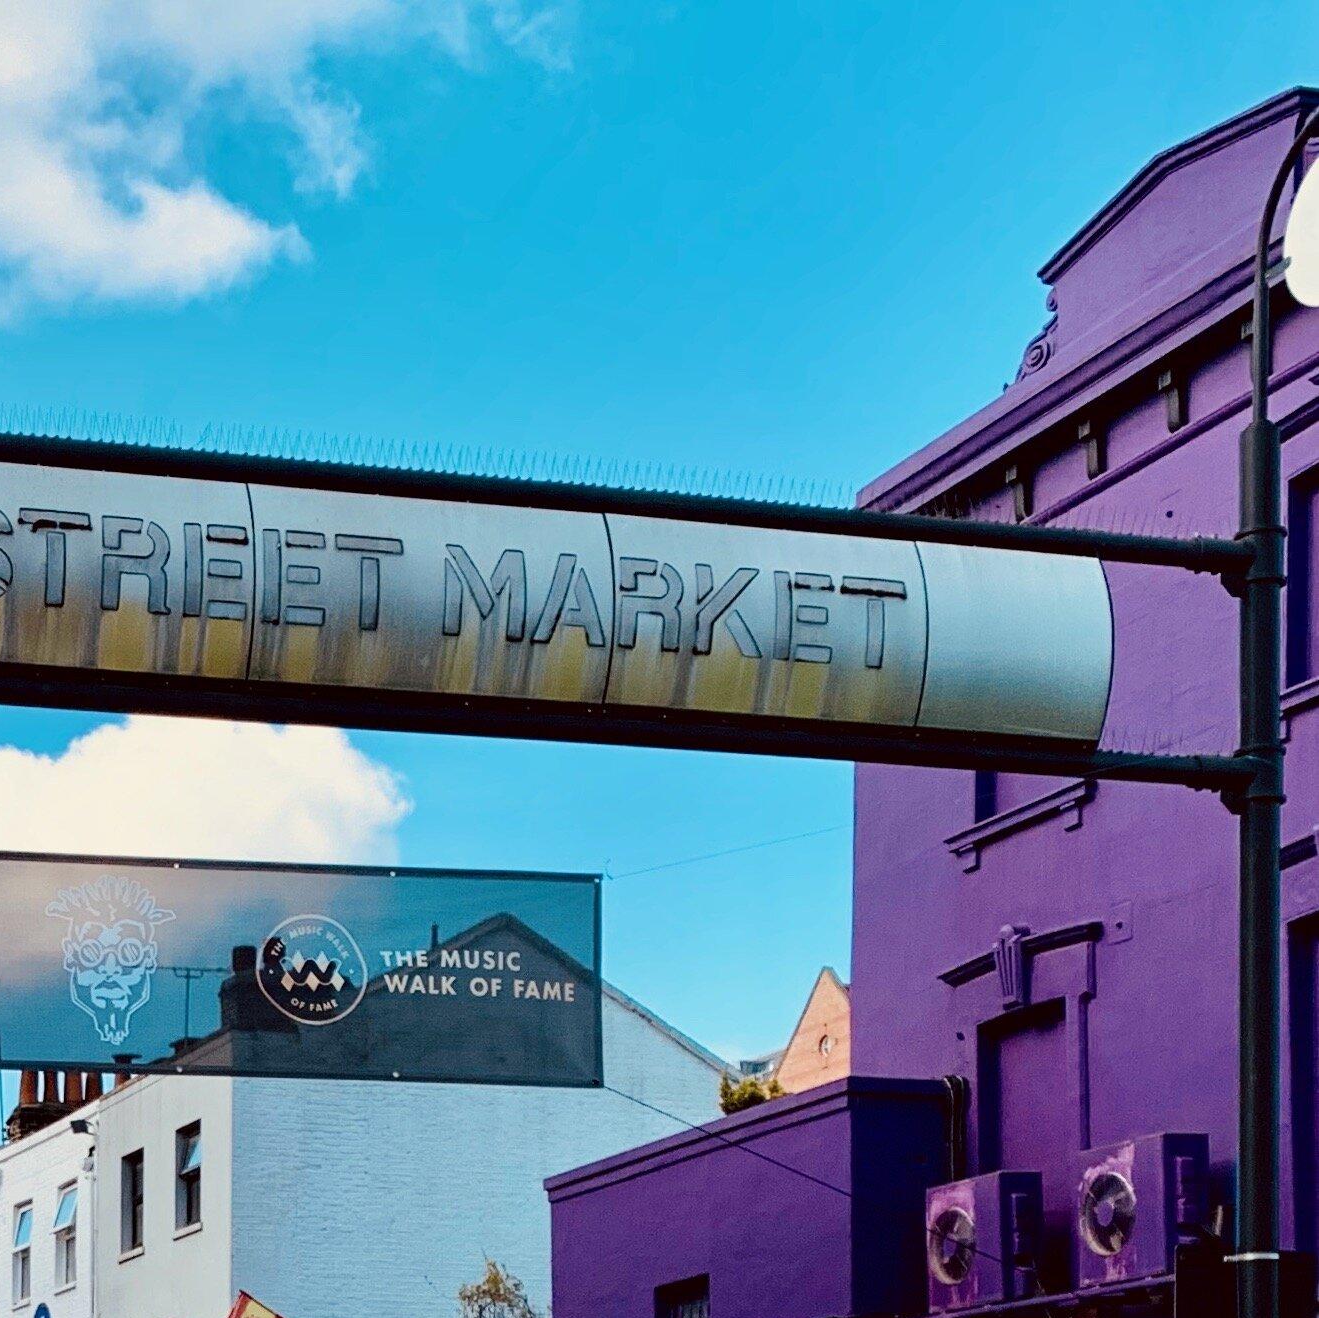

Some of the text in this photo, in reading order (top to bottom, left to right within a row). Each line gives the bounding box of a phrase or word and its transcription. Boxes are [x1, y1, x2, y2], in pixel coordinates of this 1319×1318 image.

[442, 543, 908, 669] MARKET
[270, 926, 350, 959] THE MUSIC WALK
[380, 948, 522, 973] THE MUSIC
[383, 972, 576, 1002] WALK OF FAME
[290, 997, 339, 1012] OF FAME
